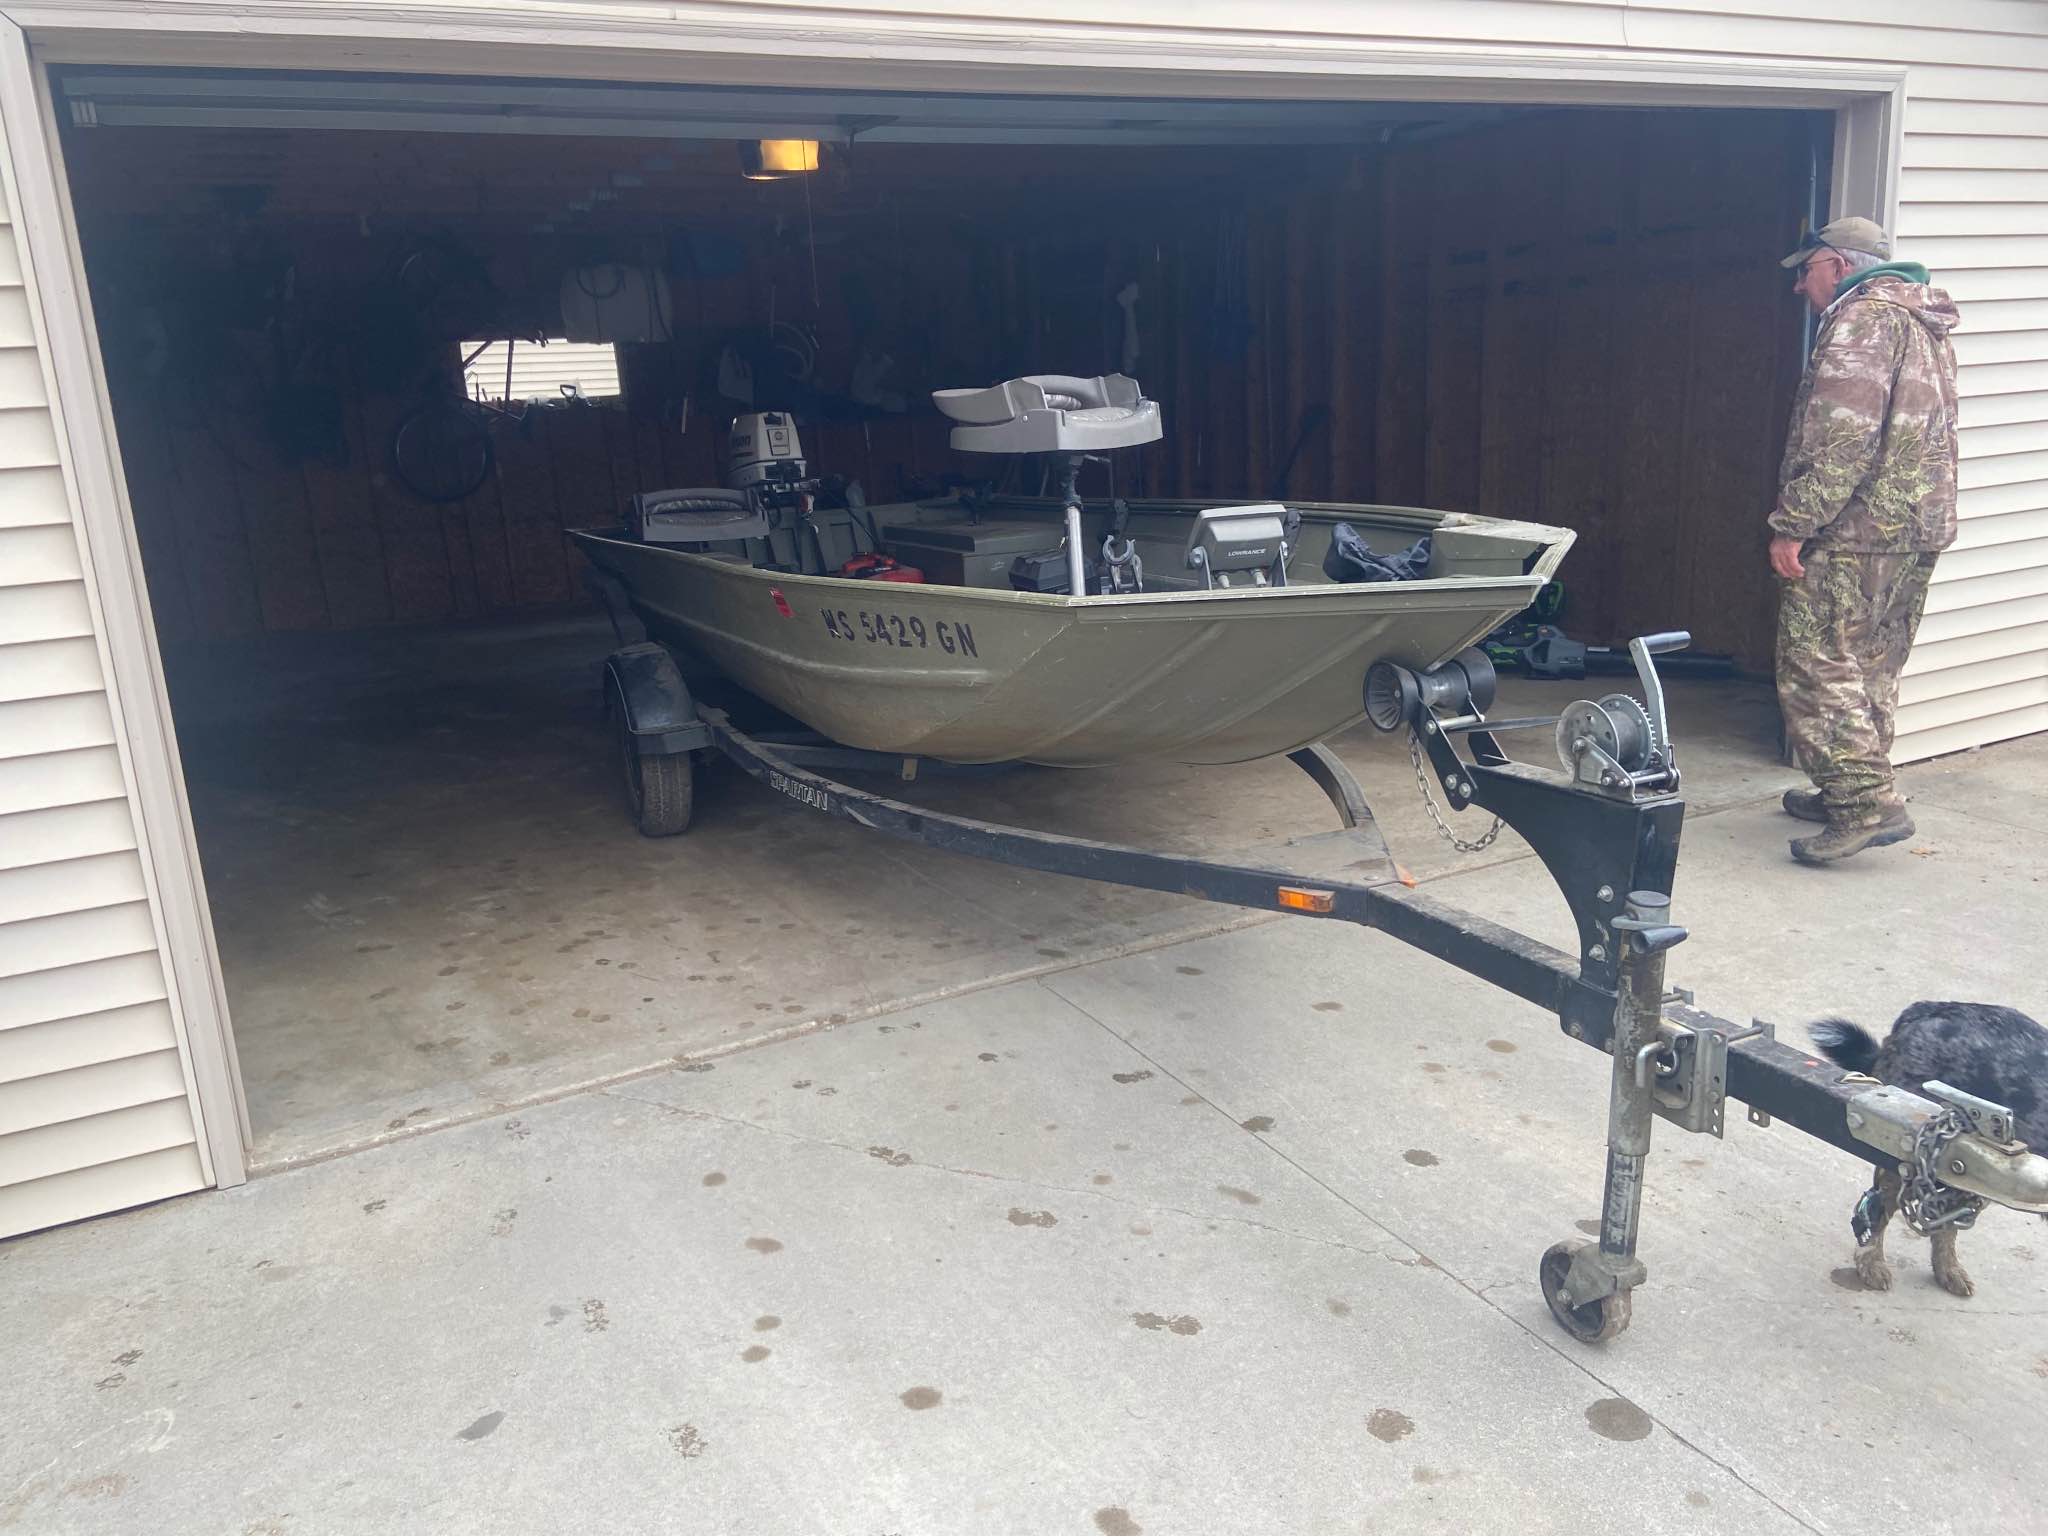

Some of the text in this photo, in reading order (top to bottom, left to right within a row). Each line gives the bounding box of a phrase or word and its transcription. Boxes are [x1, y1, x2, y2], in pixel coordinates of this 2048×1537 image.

[1227, 548, 1267, 557] LOWRANCE
[859, 611, 927, 648] 5429
[935, 620, 979, 658] GN
[769, 770, 828, 811] SPARTAN
